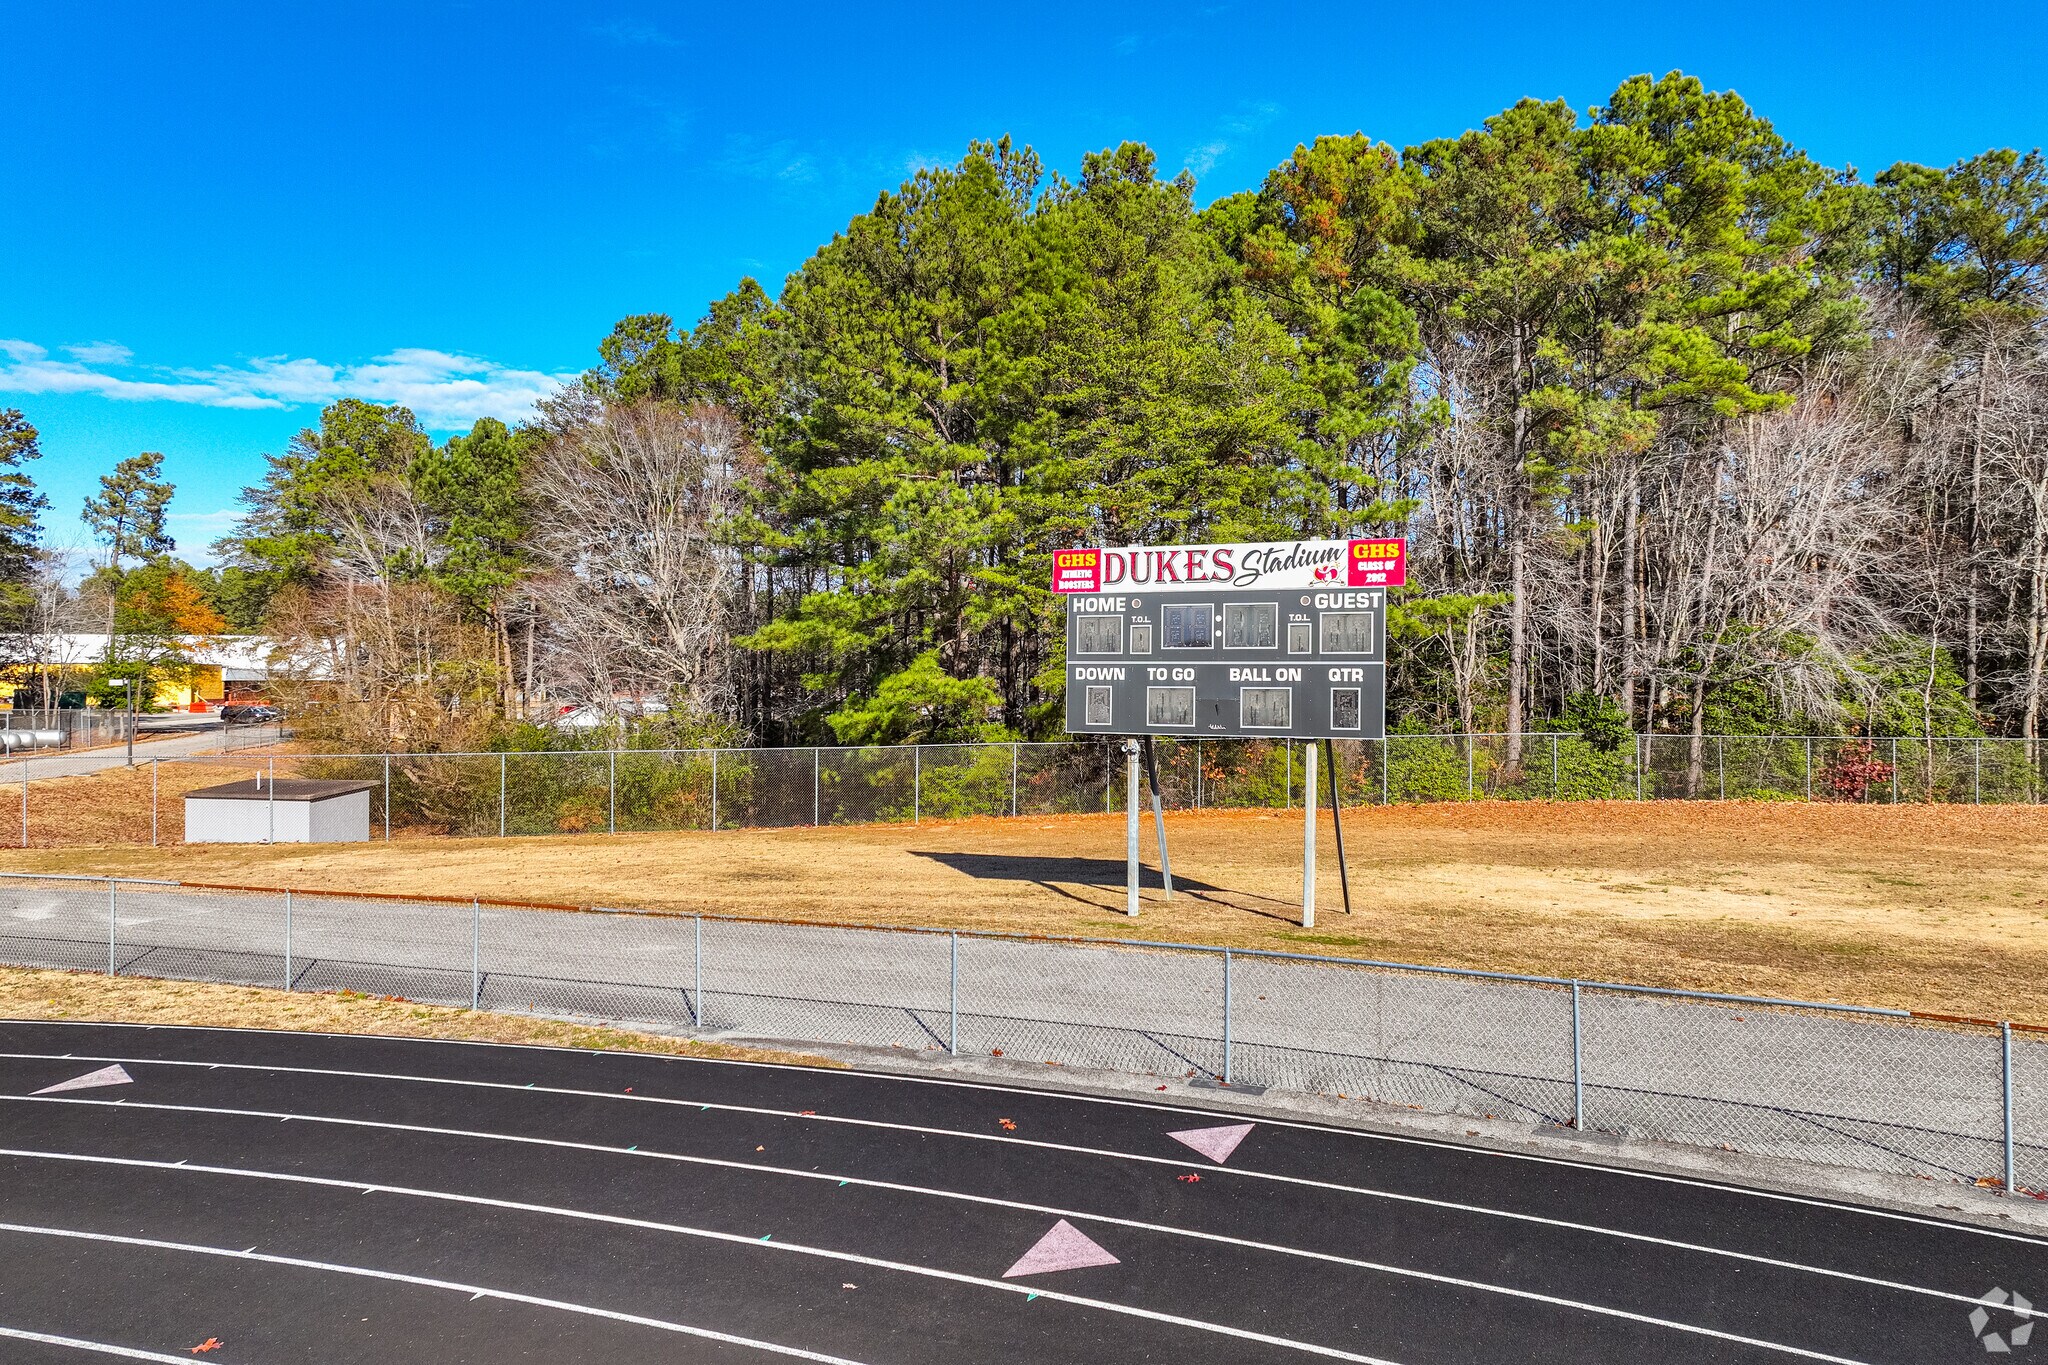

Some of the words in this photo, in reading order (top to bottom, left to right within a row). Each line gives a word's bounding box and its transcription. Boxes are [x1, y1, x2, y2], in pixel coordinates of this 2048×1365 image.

[1353, 543, 1400, 559] GHS
[1058, 553, 1097, 568] GHS
[1103, 549, 1236, 585] DUKES
[1233, 543, 1346, 587] Stadium
[1357, 560, 1384, 571] CLASS
[1385, 560, 1396, 570] OF
[1061, 569, 1092, 579] ATHLETIC
[1365, 573, 1387, 583] 2012
[1058, 580, 1095, 590] BOOSTERS
[1073, 597, 1127, 612] HOME
[1314, 592, 1382, 609] GUEST
[1288, 613, 1310, 622] T.O.L.
[1075, 667, 1125, 681] DOWN
[1147, 667, 1168, 681] TO
[1172, 667, 1195, 682] GO
[1229, 668, 1271, 682] BALL
[1275, 668, 1302, 682] ON
[1328, 668, 1364, 682] QTR
